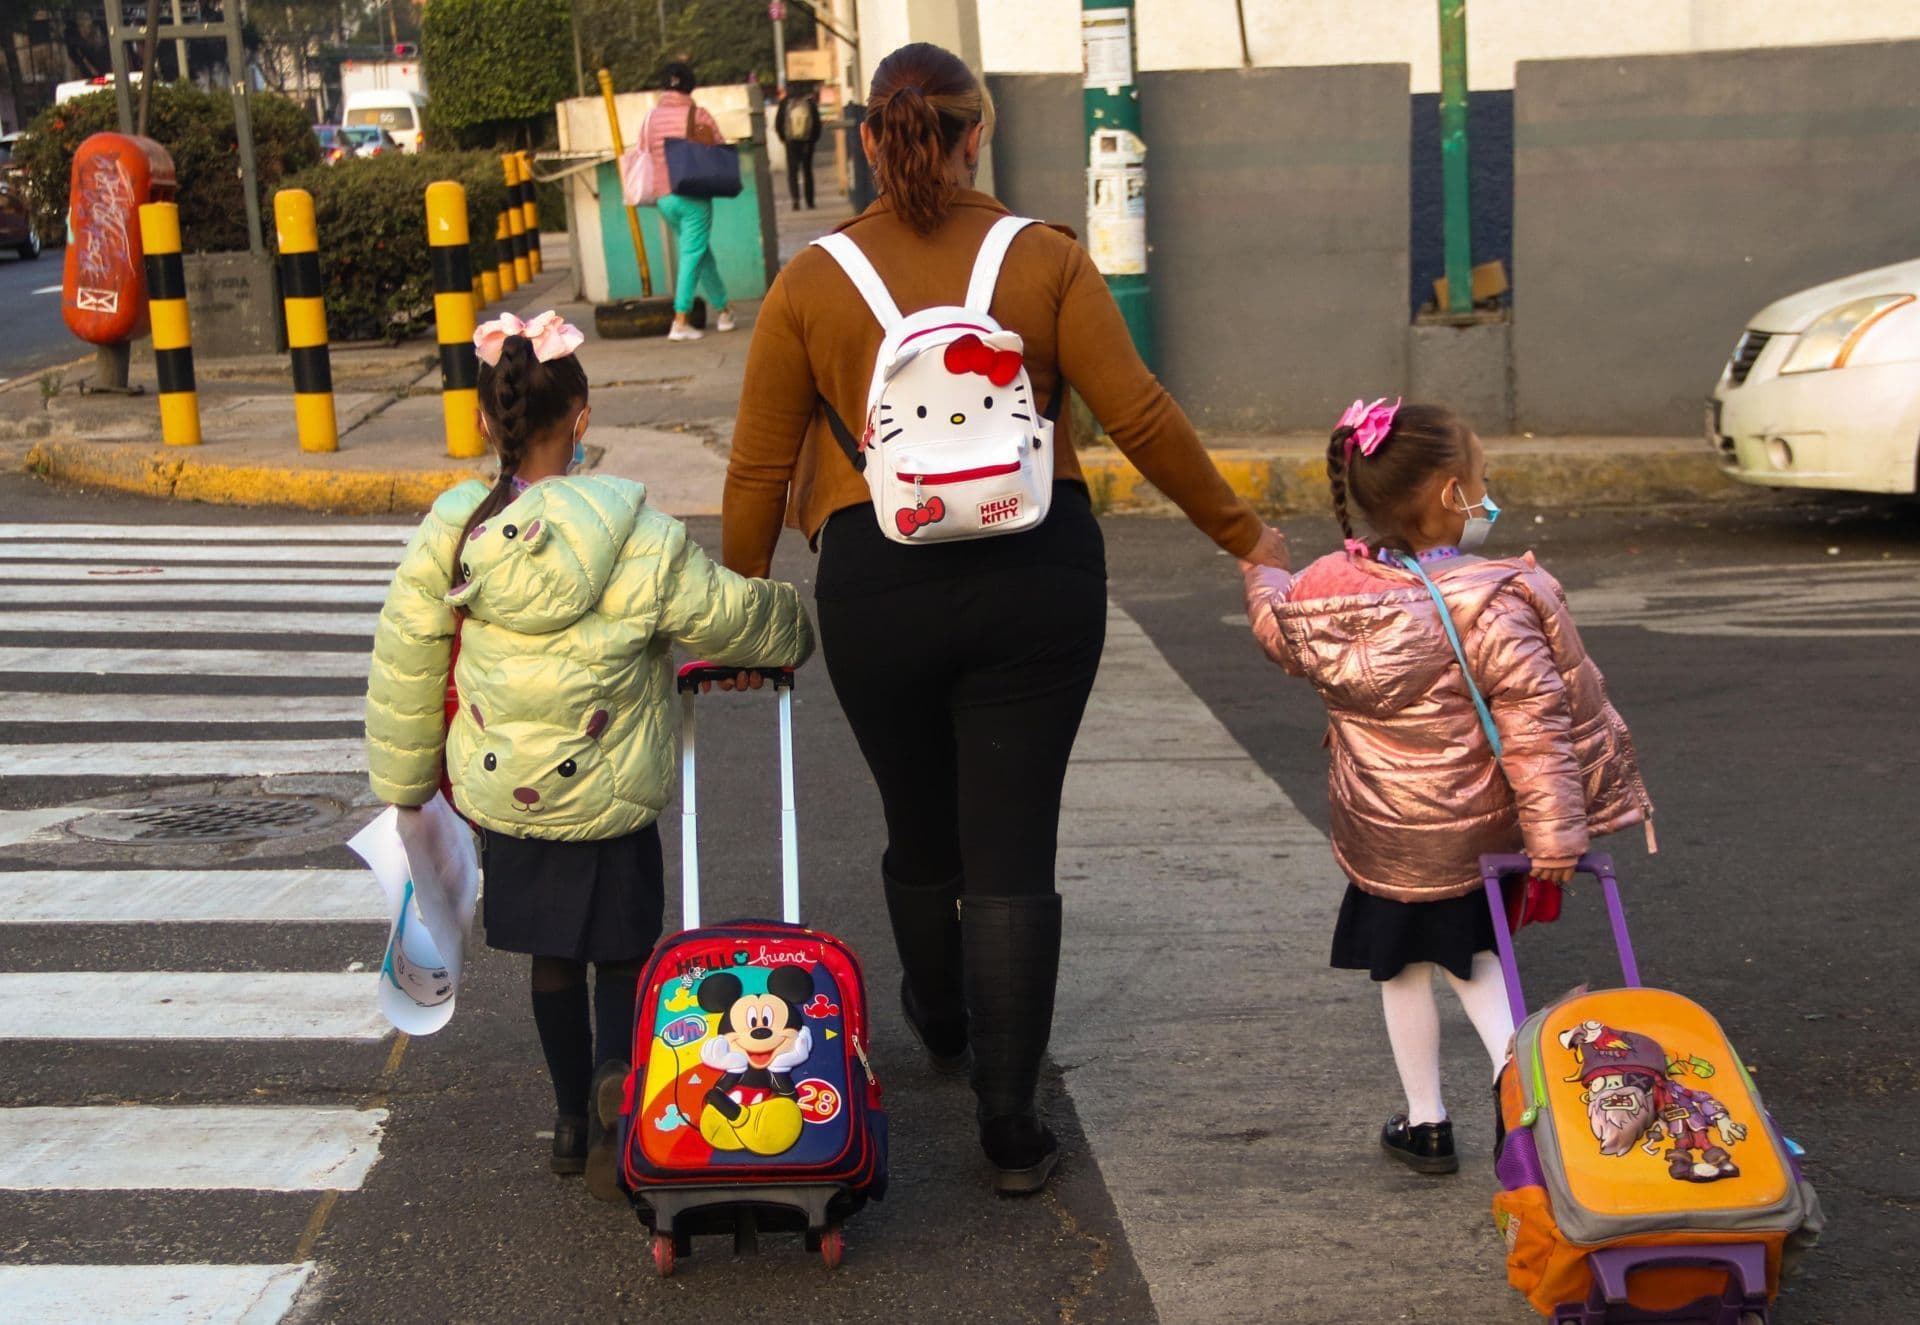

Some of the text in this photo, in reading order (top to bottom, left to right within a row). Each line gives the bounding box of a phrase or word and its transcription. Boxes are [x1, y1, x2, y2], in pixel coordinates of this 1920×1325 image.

[980, 497, 1018, 515] HELLO
[981, 506, 1018, 525] KITTY
[747, 945, 818, 966] friend
[797, 1084, 836, 1115] 28
